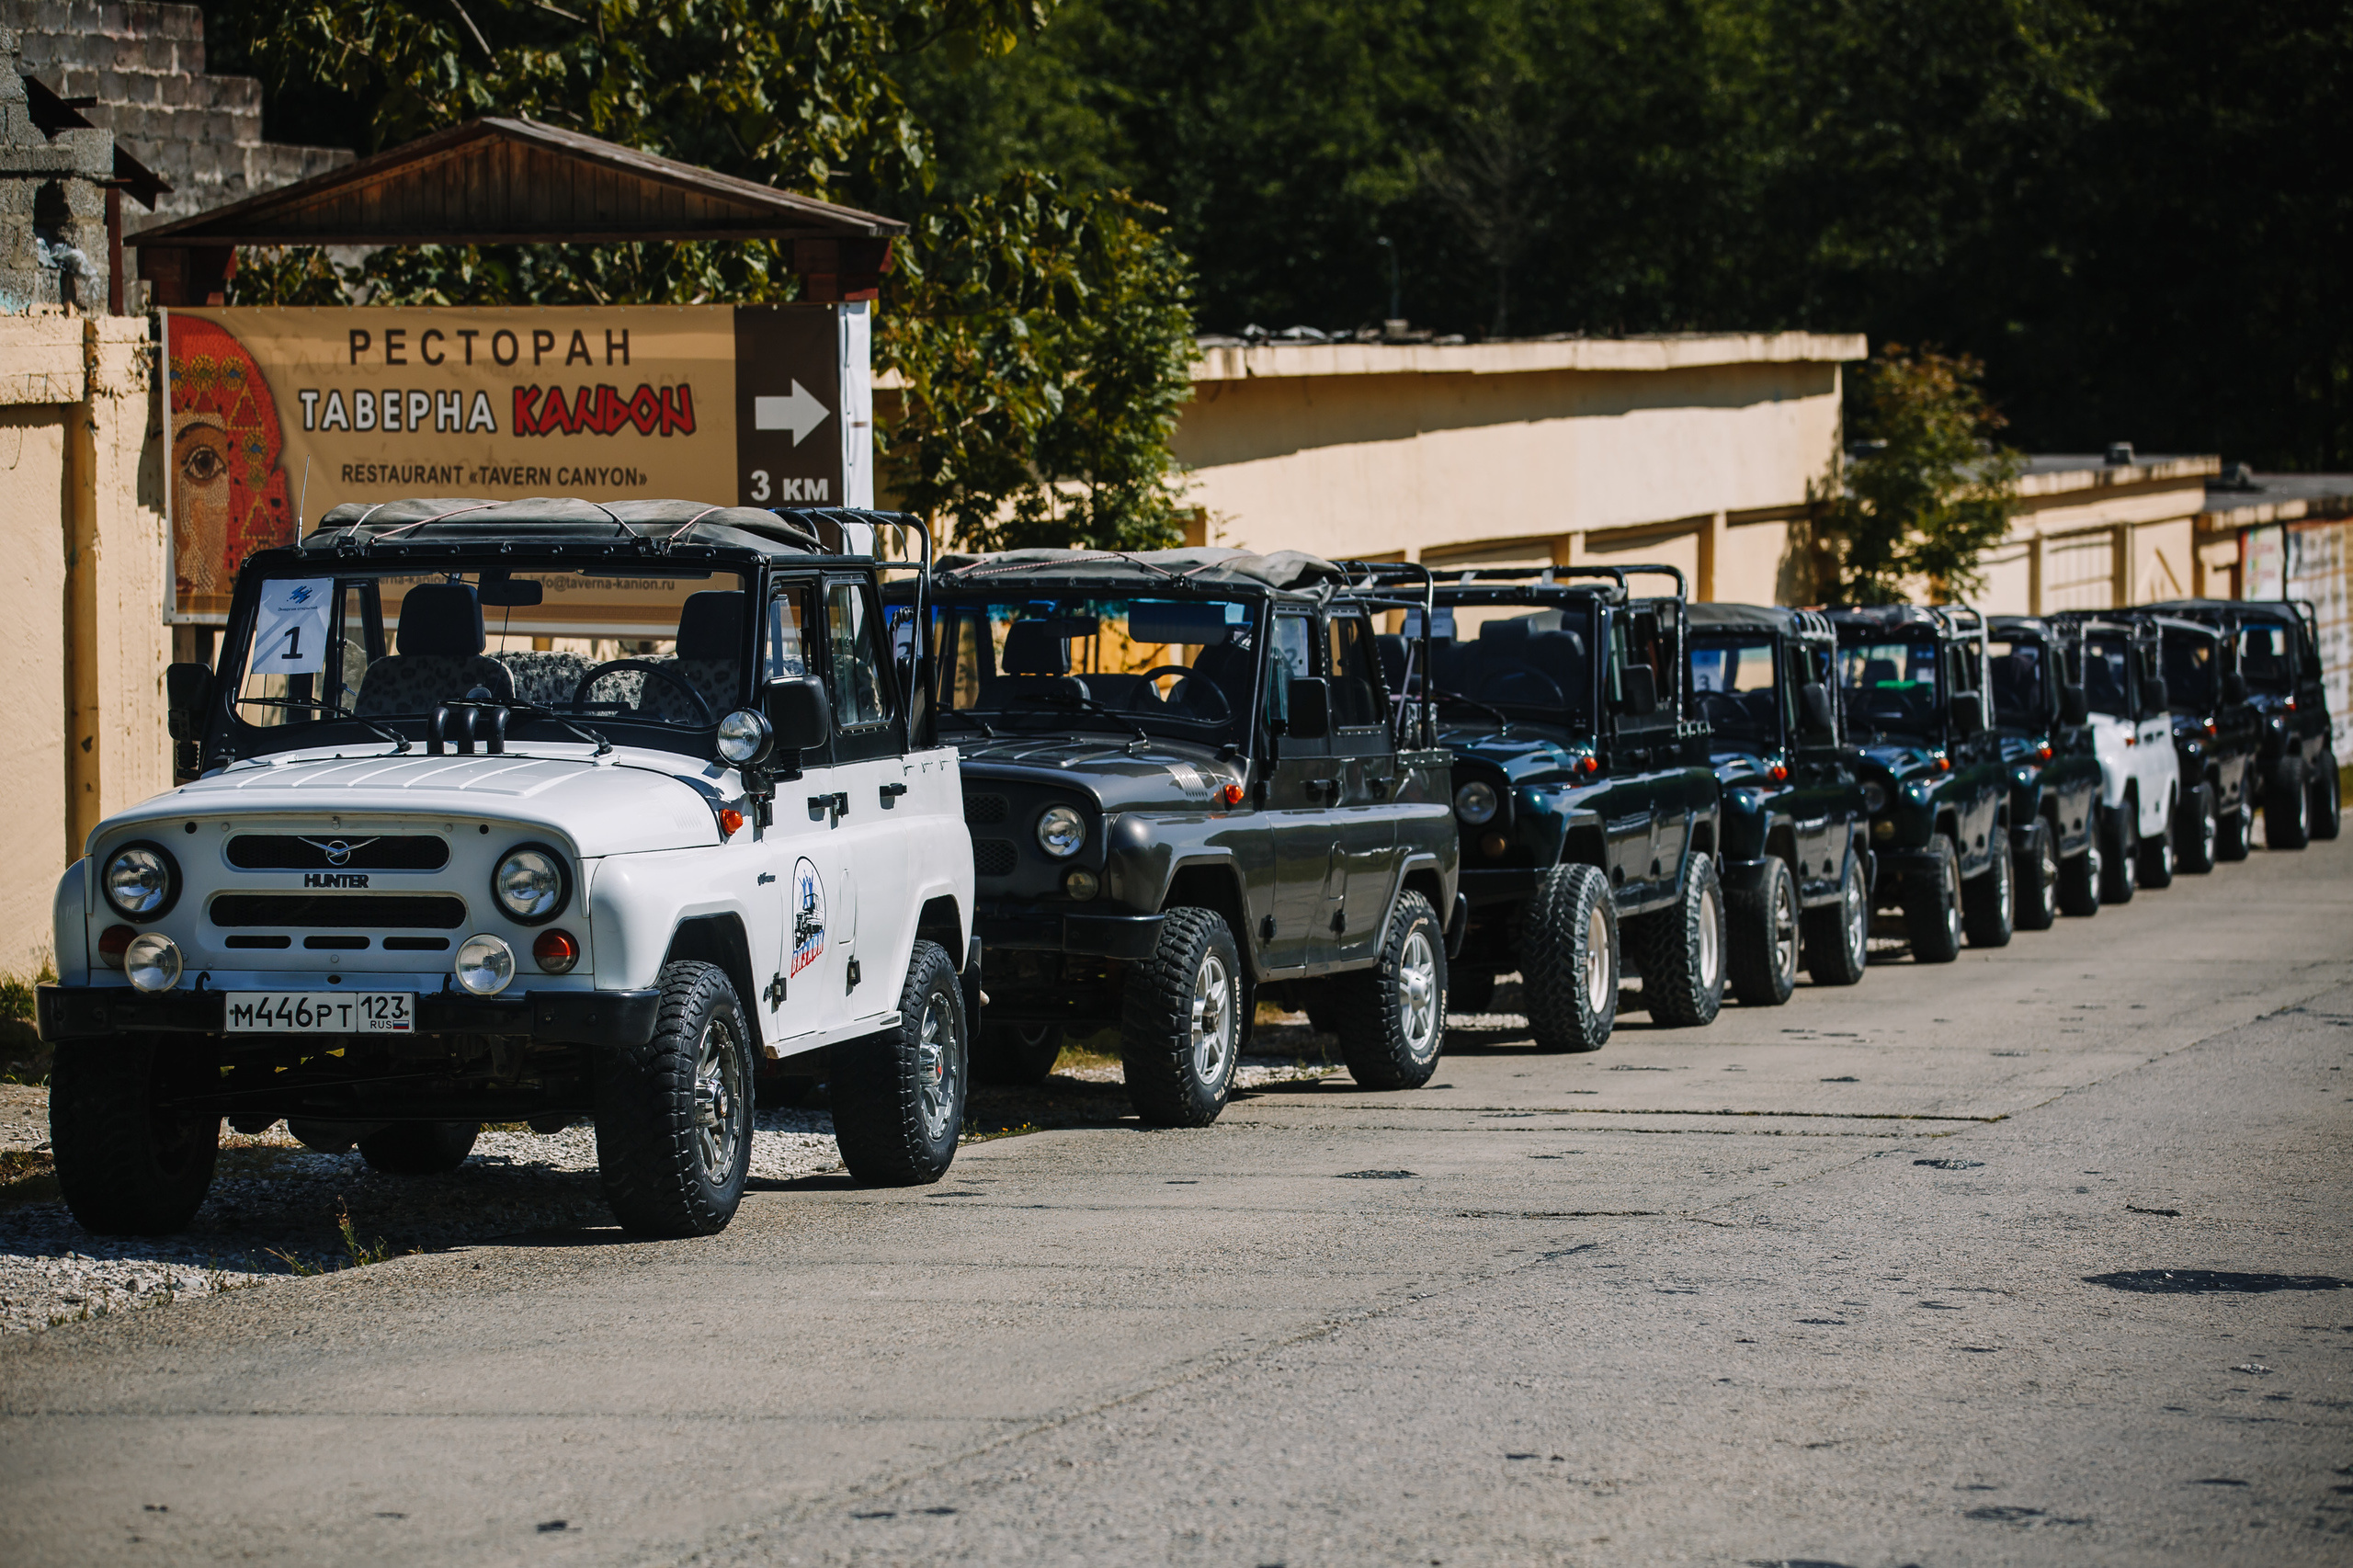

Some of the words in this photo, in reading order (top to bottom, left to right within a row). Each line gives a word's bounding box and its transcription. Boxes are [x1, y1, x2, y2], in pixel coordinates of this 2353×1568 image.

[350, 328, 631, 367] РЕСТОРАН
[299, 388, 498, 433] ТАВЕРНА
[341, 463, 464, 485] RESTAURANT
[751, 469, 771, 502] 3
[281, 626, 303, 659] 1
[304, 874, 369, 888] HUNTER
[360, 995, 404, 1019] 123
[369, 1020, 392, 1029] RUS
